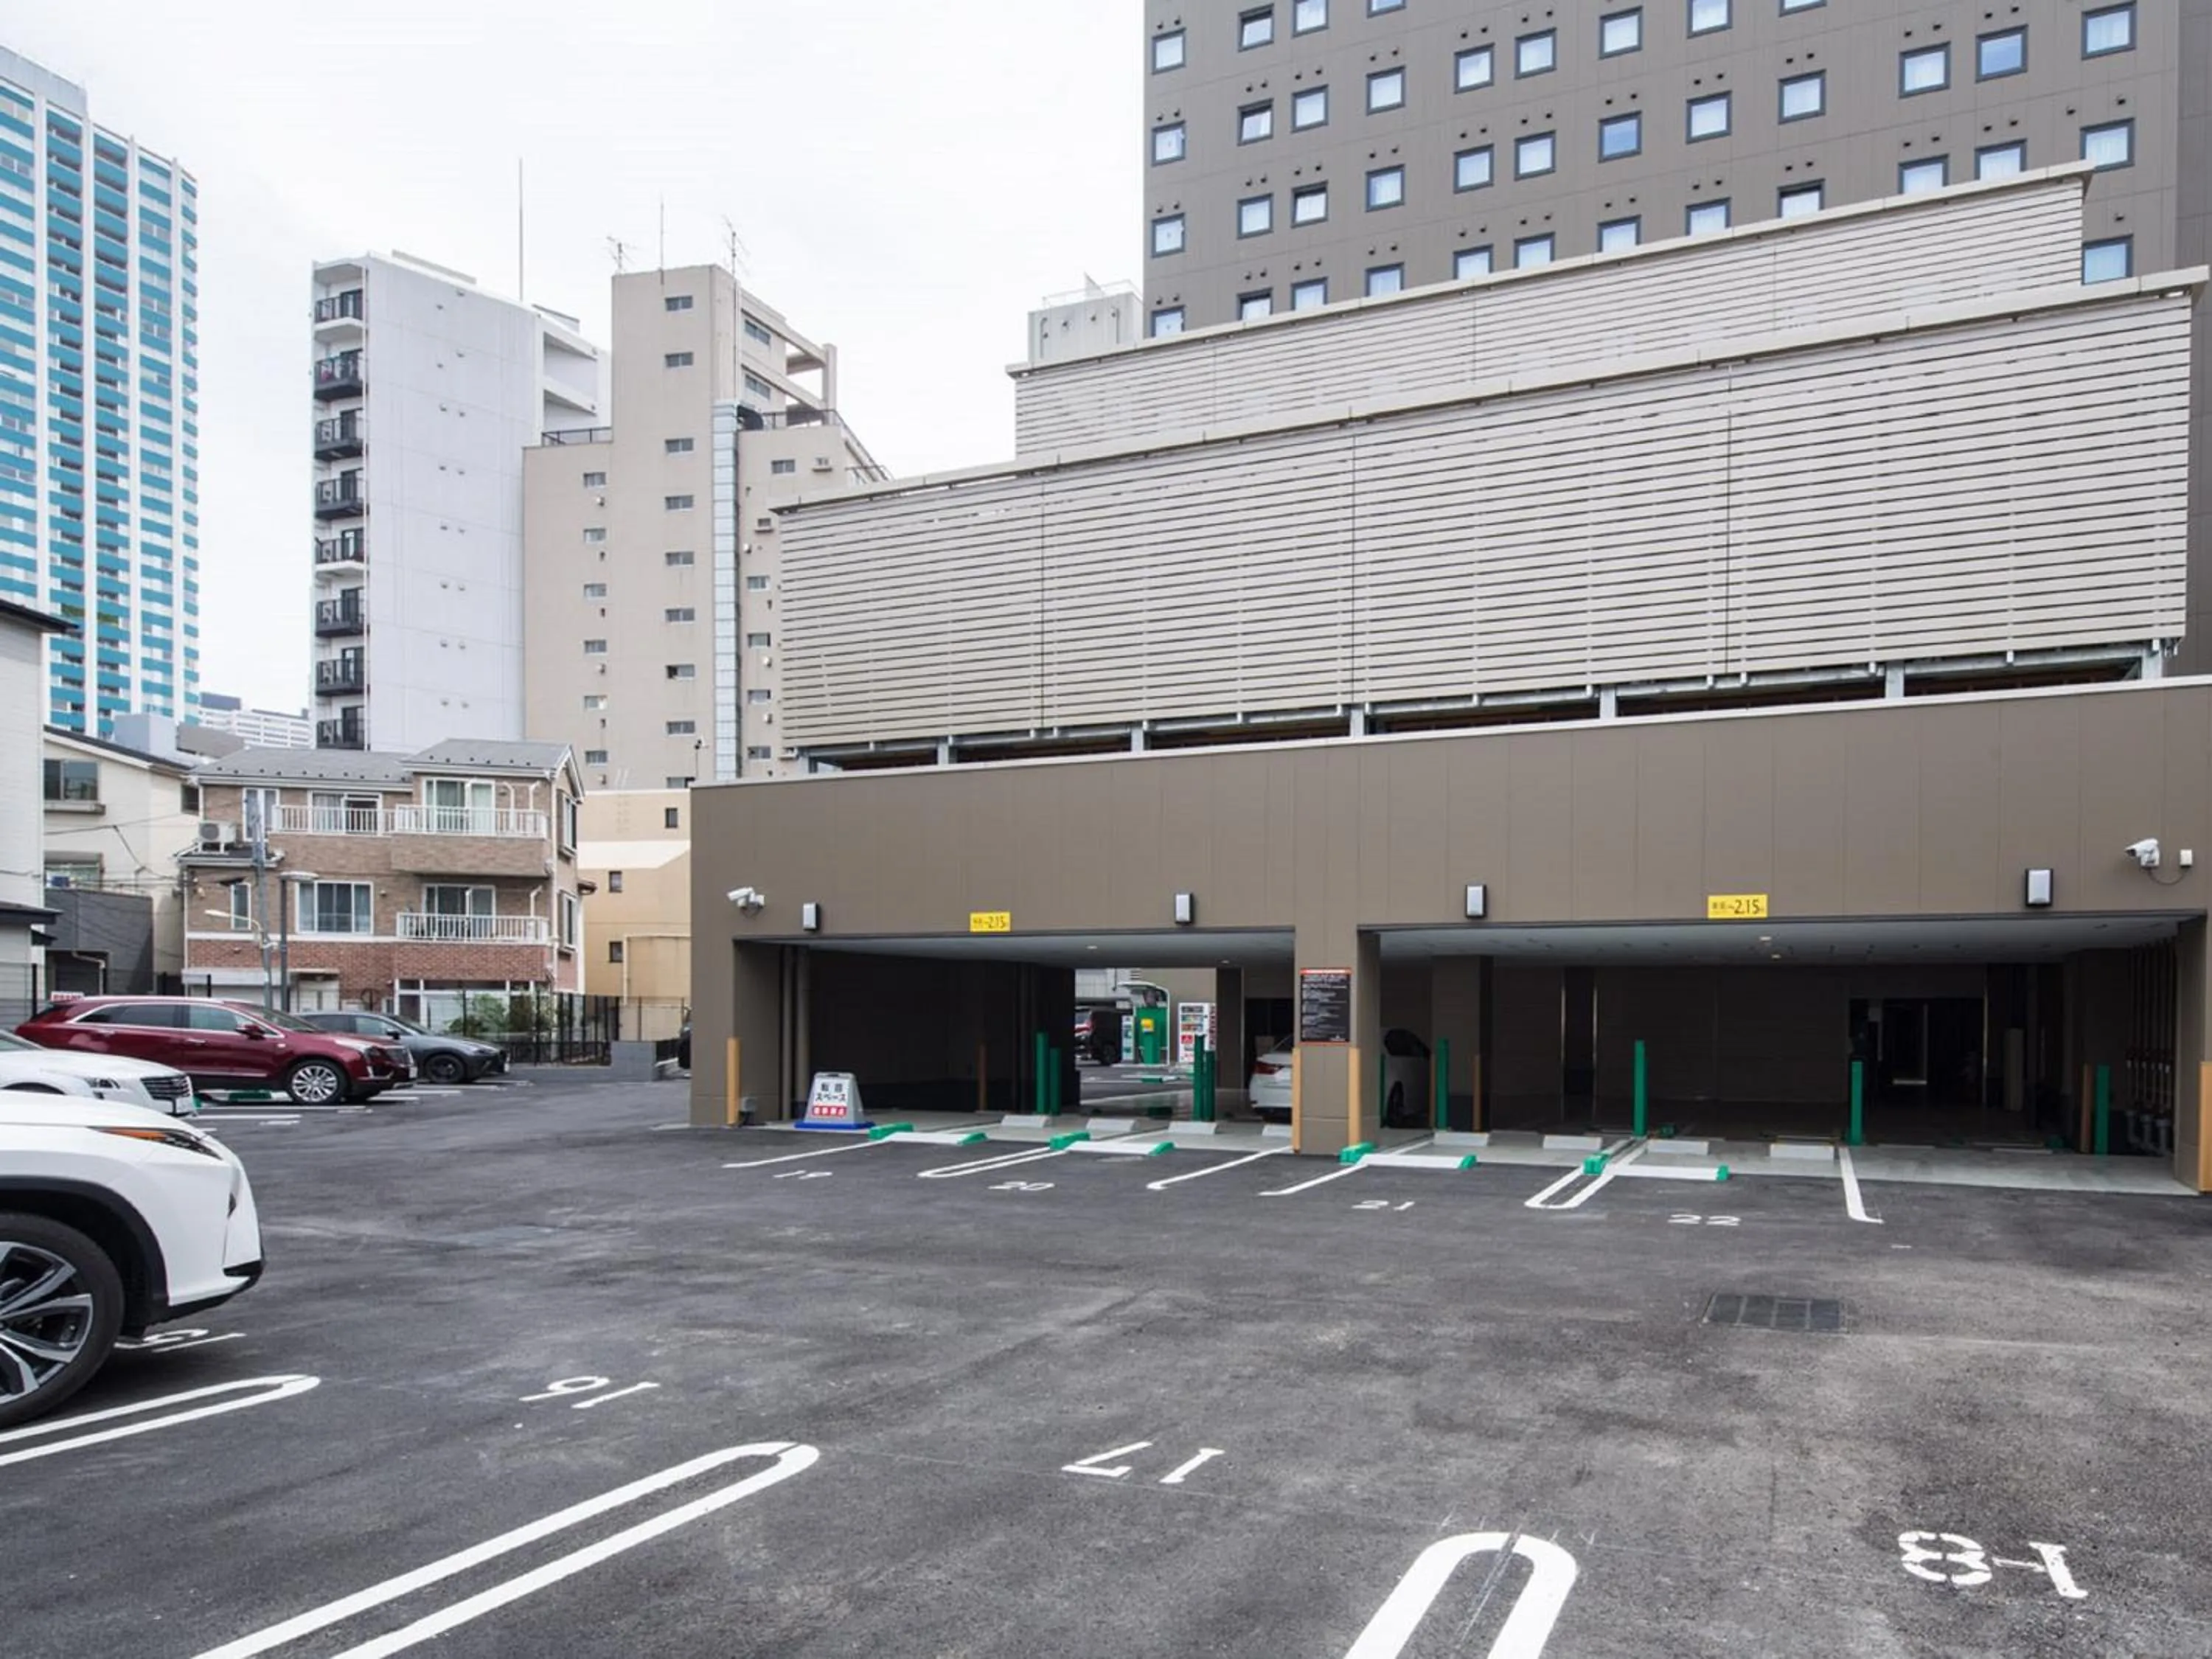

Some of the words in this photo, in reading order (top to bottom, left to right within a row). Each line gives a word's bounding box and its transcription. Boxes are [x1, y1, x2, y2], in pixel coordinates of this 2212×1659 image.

[815, 1093, 846, 1102] スペース
[988, 1181, 1054, 1191] 20
[1352, 1200, 1414, 1211] 21
[1668, 1214, 1741, 1226] 22
[520, 1375, 661, 1408] 16
[1062, 1441, 1225, 1484] 17
